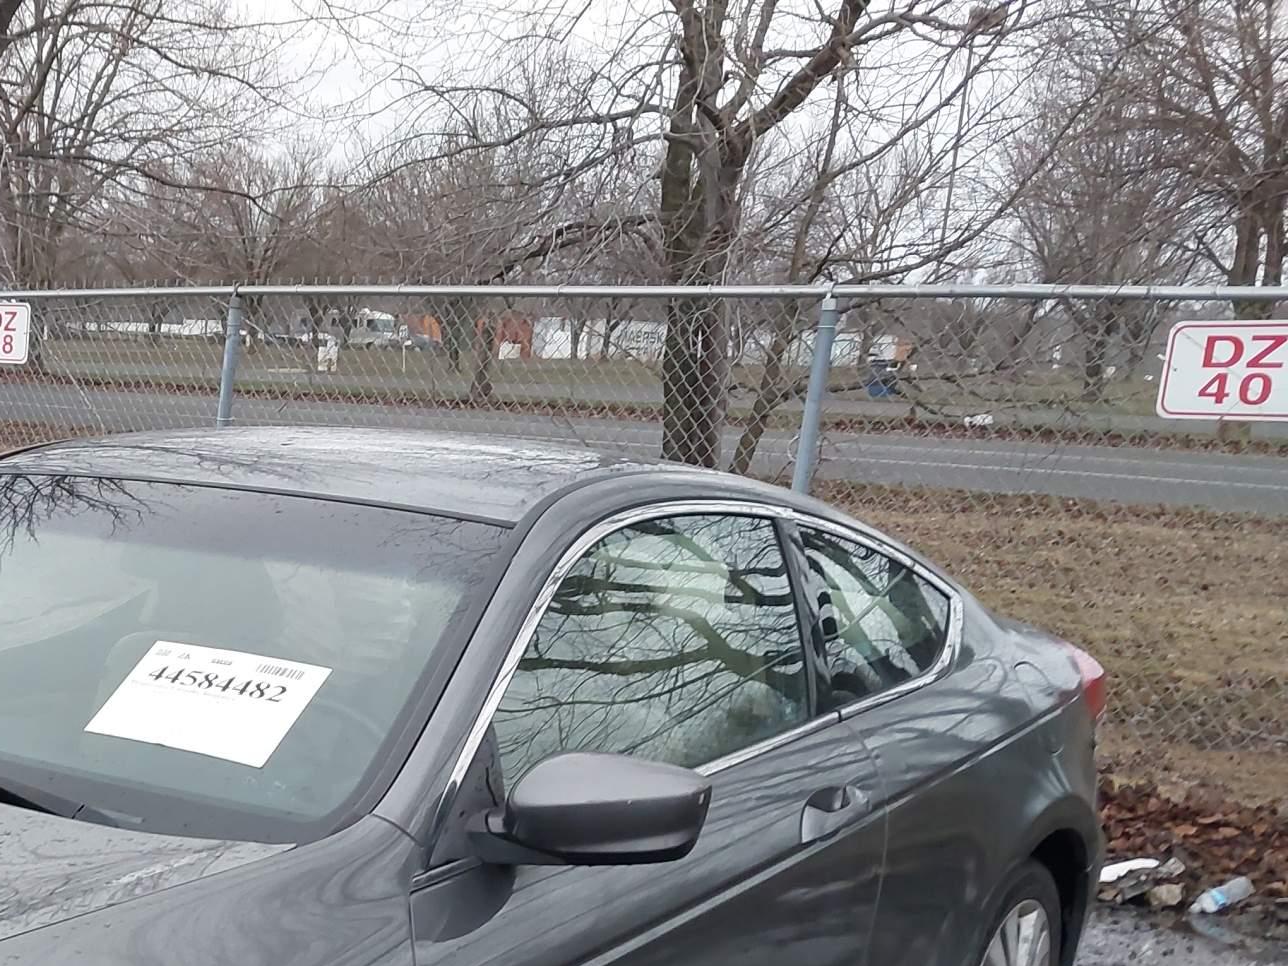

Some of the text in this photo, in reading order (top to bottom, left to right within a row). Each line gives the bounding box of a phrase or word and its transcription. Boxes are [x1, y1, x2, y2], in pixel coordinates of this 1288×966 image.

[1202, 335, 1288, 368] DZ
[1197, 372, 1273, 406] 40
[148, 665, 288, 703] 44584482
